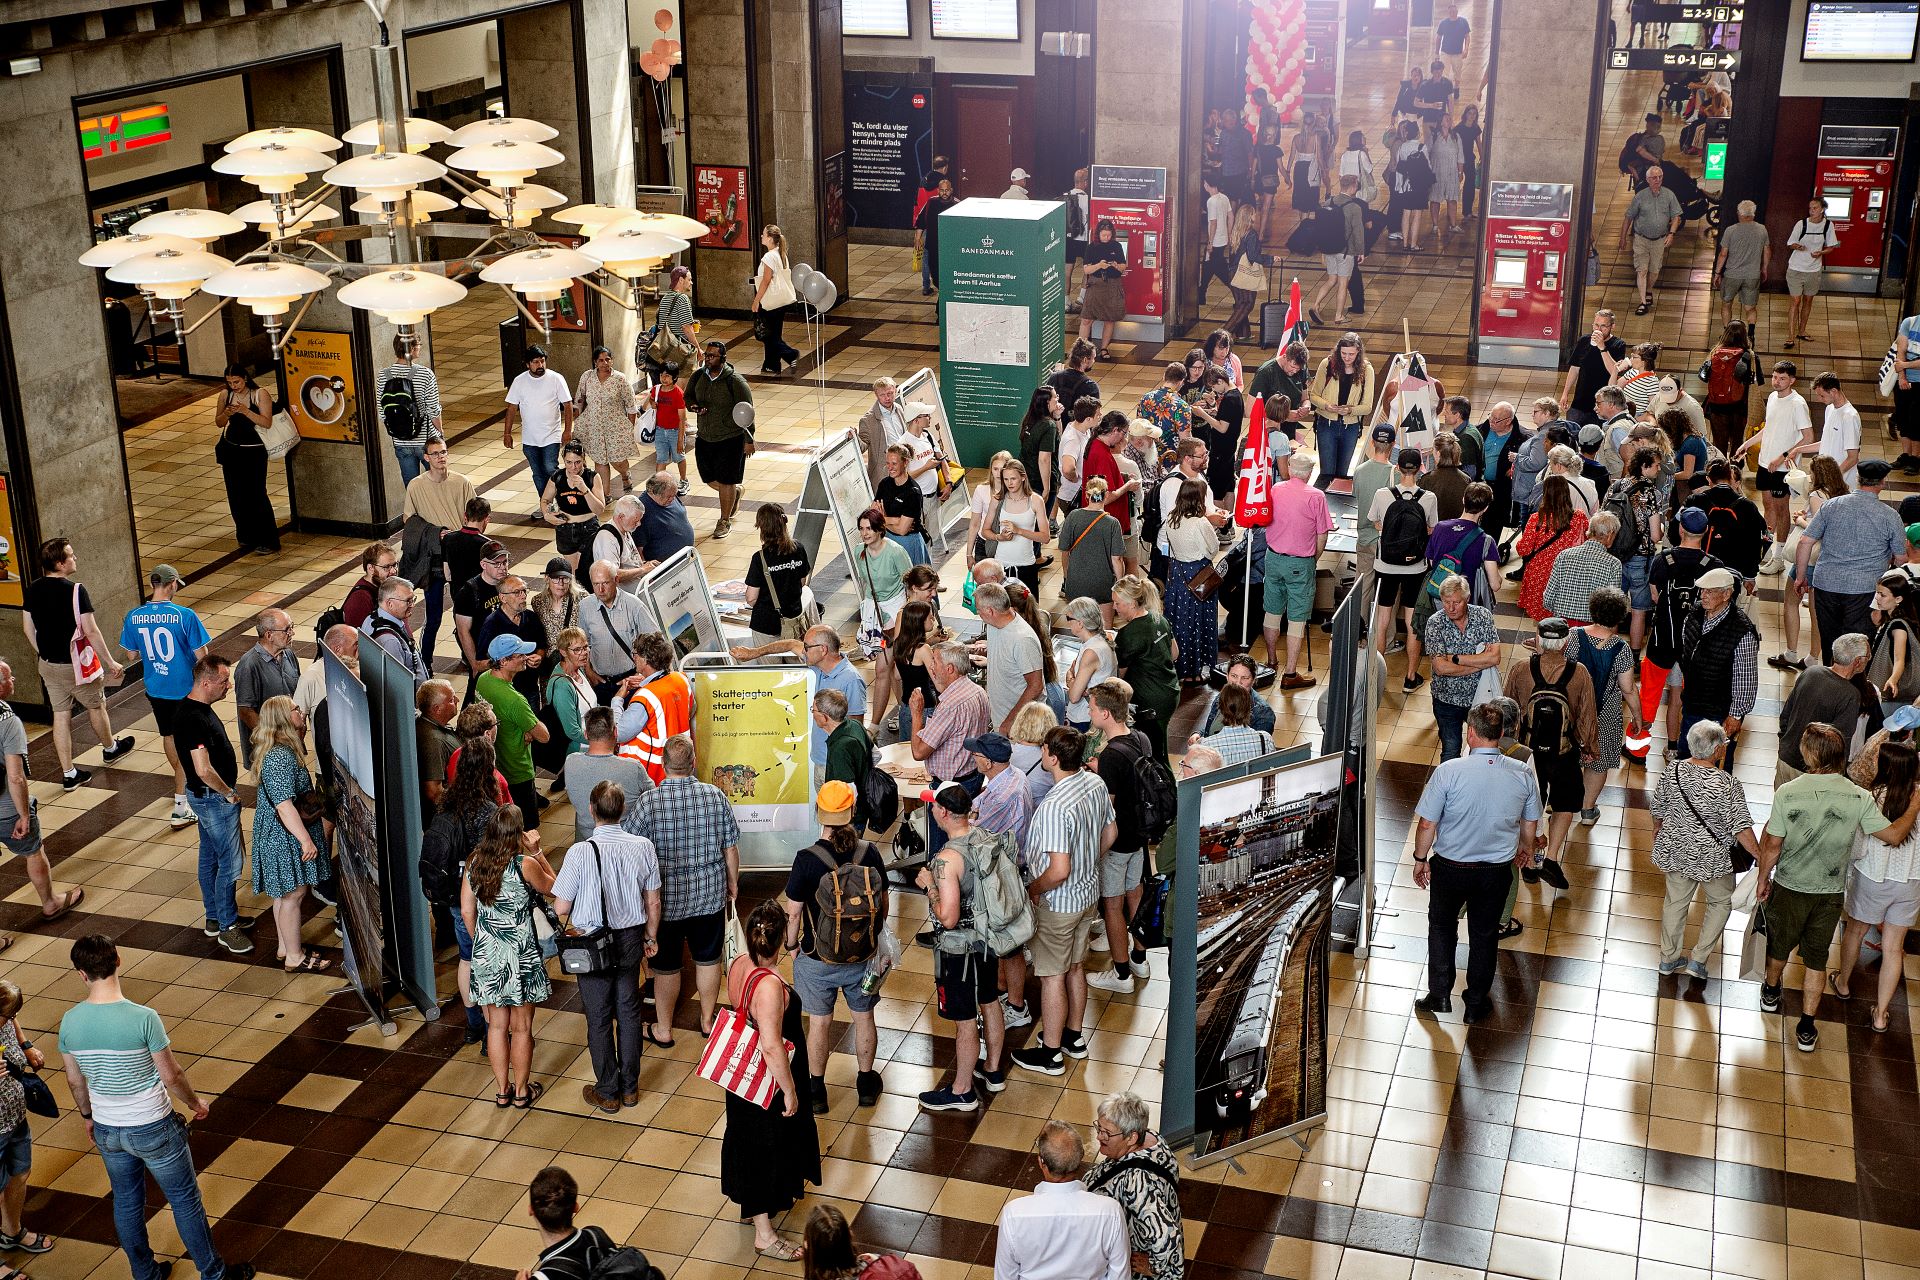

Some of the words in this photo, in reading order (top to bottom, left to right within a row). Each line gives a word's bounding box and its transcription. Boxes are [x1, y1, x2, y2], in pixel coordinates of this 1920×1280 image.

[1694, 9, 1712, 18] 2-3
[1678, 54, 1696, 64] 0-1
[852, 122, 865, 130] Tak,
[866, 122, 882, 130] fordi
[852, 130, 877, 138] hensyn,
[961, 247, 1014, 256] BANEDANMARK
[953, 270, 996, 279] Banedanmark
[296, 349, 341, 360] BARISTAKAFFE
[132, 614, 179, 624] MARADONA
[138, 627, 174, 662] 10
[712, 689, 773, 700] Skattejagten
[713, 702, 745, 710] starter
[1242, 802, 1301, 822] BANEDANMARK
